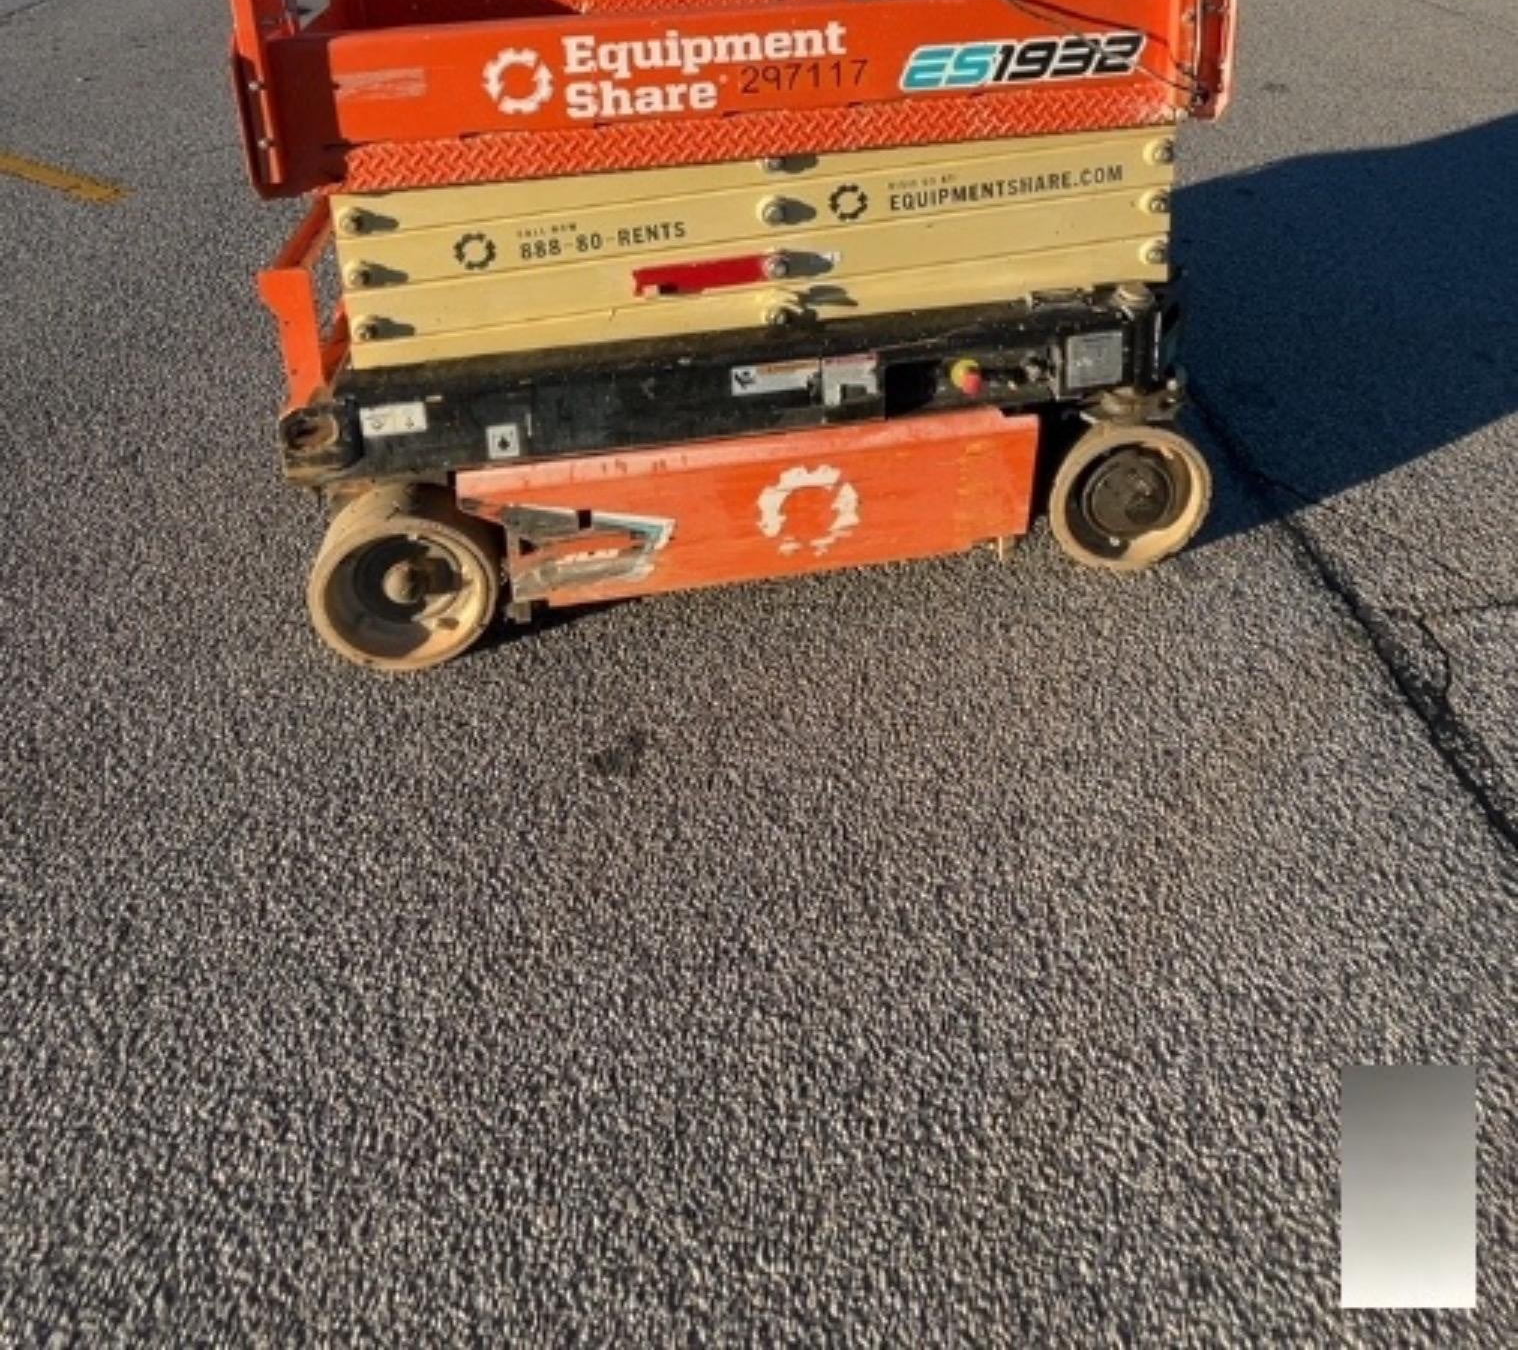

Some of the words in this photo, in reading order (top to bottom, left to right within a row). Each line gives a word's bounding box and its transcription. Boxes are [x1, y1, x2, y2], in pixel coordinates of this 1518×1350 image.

[561, 21, 847, 78] Equipment
[902, 31, 1145, 90] ES1932
[740, 58, 869, 94] 297117
[565, 80, 718, 119] Share
[889, 164, 1123, 211] EQUIPMENTSHARE.COM
[519, 221, 686, 261] 888-80-RENTS
